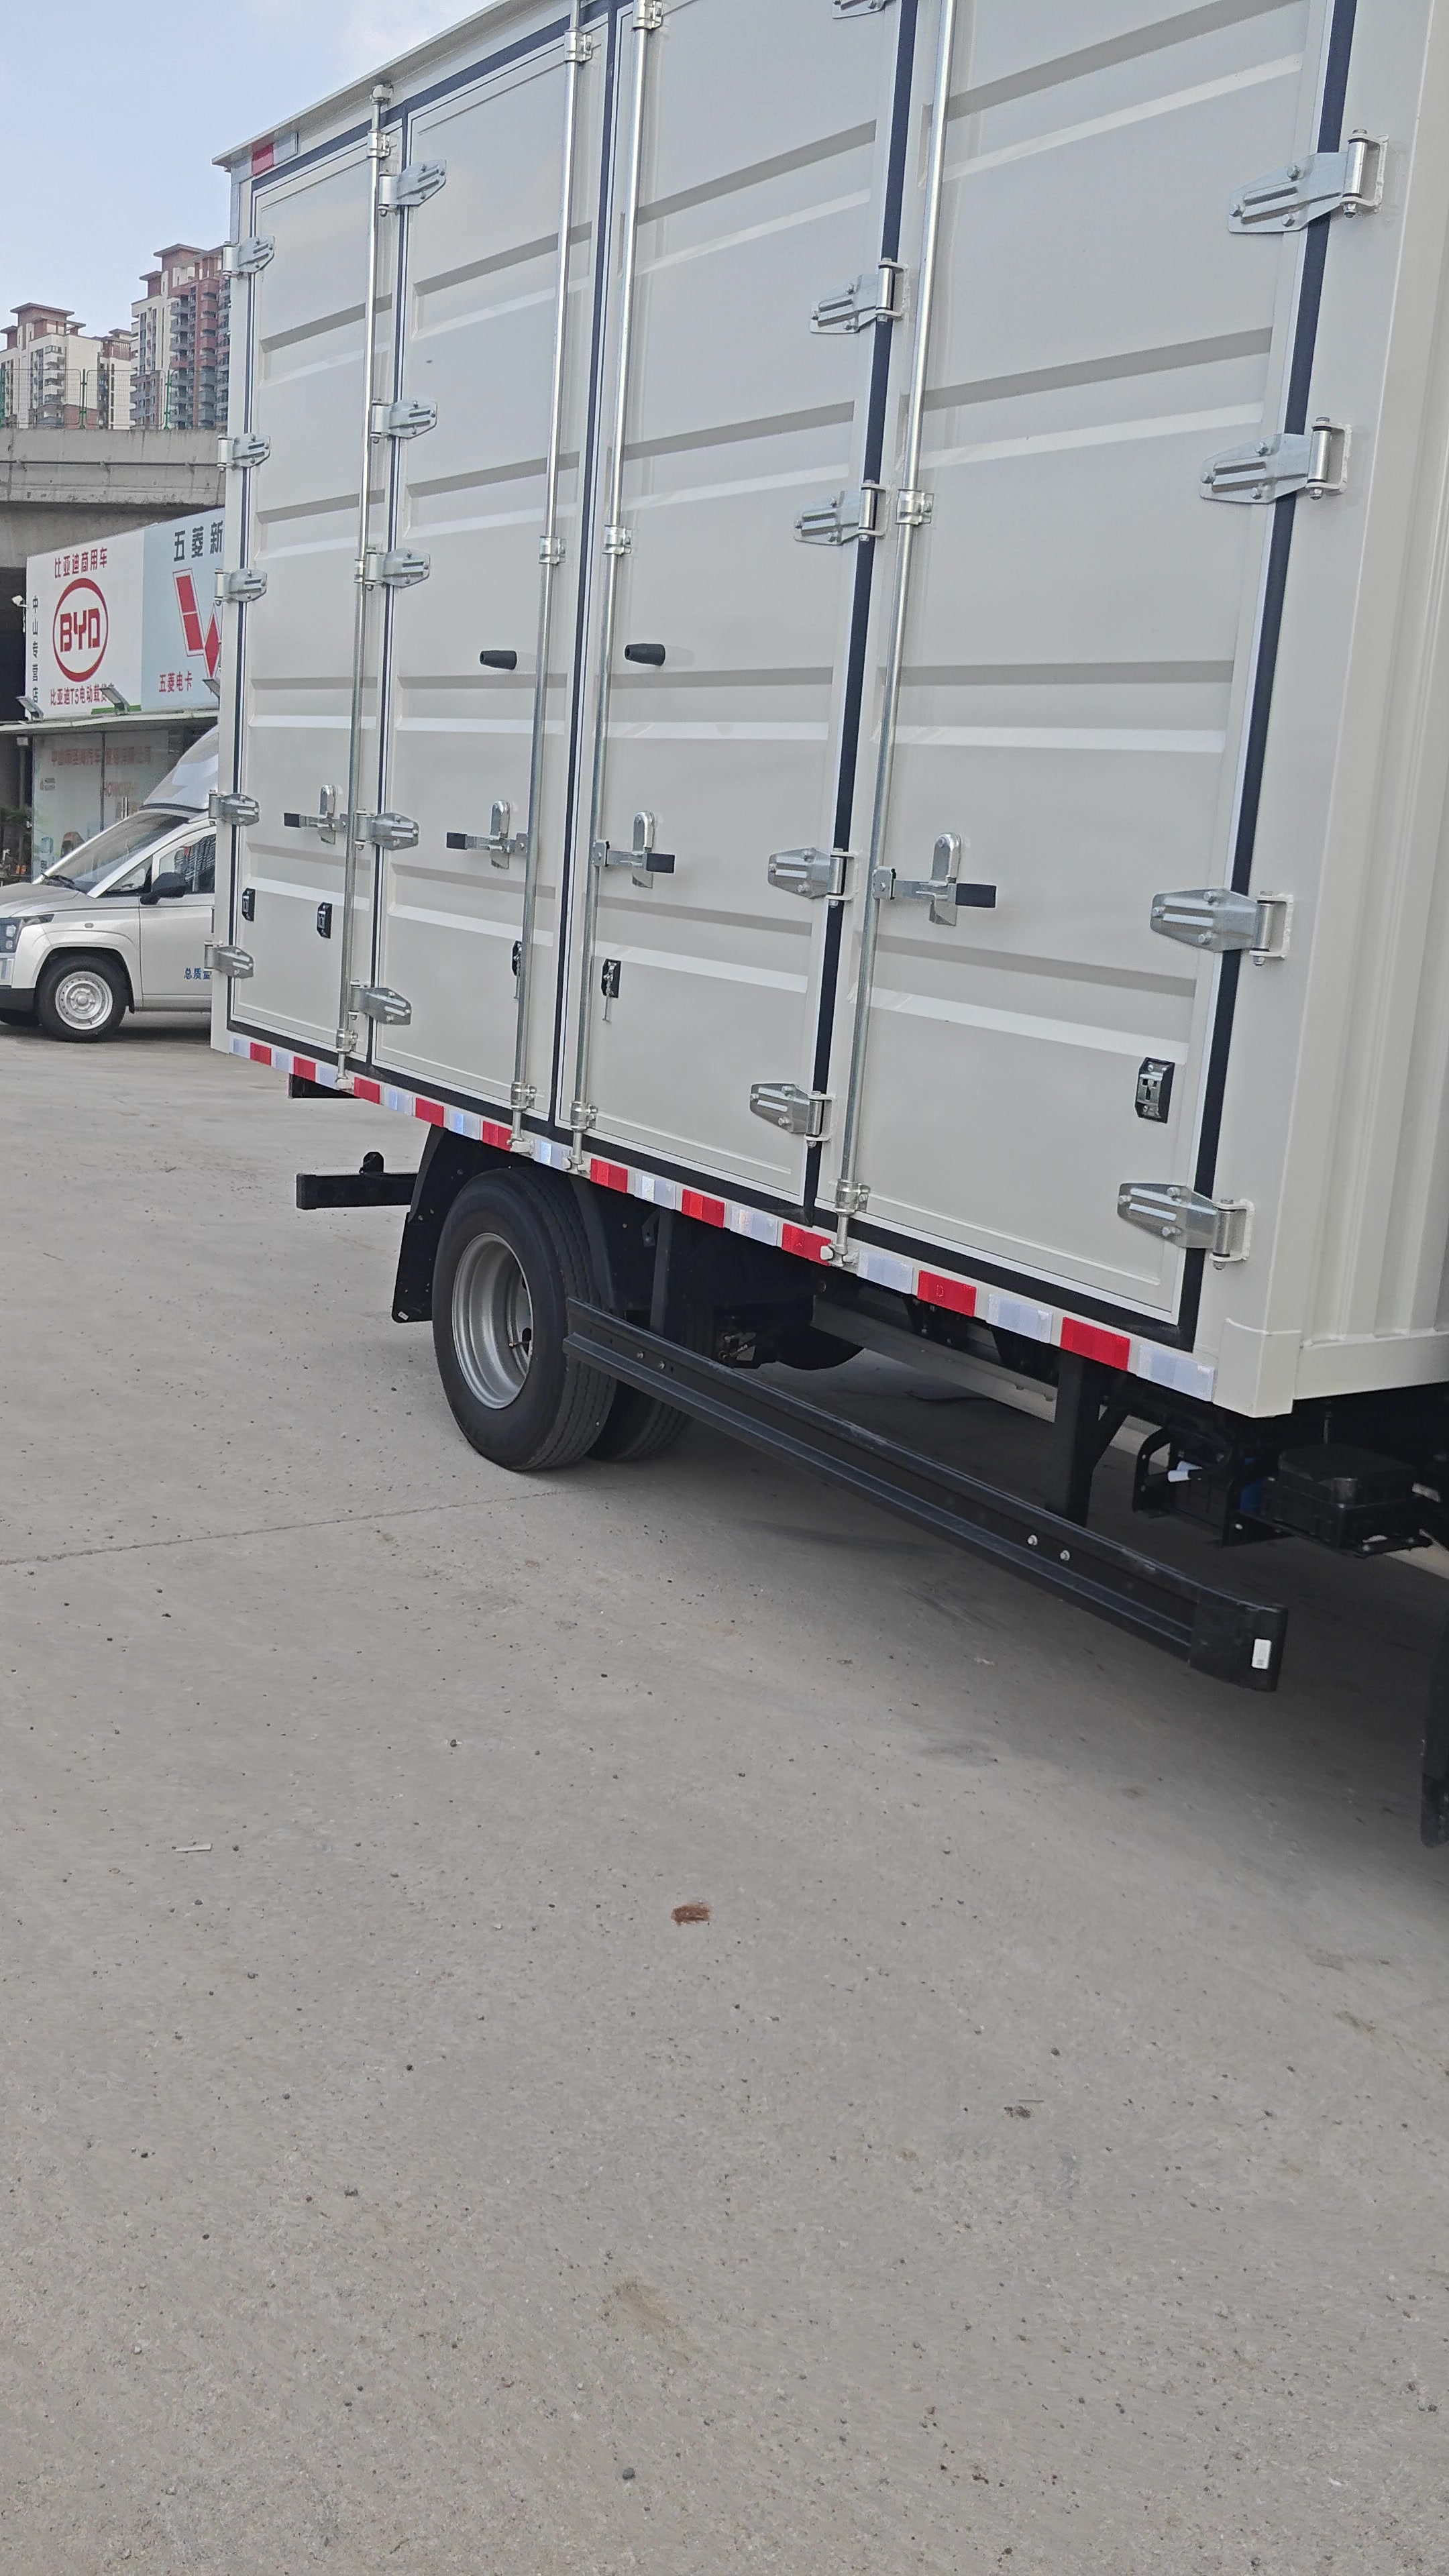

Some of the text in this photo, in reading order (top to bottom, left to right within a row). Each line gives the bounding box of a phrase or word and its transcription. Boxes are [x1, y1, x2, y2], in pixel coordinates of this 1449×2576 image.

[174, 520, 223, 561] 五菱新
[54, 547, 107, 578] 比亚迪商用车
[60, 608, 101, 653] BYD
[159, 670, 193, 692] 五菱电卡
